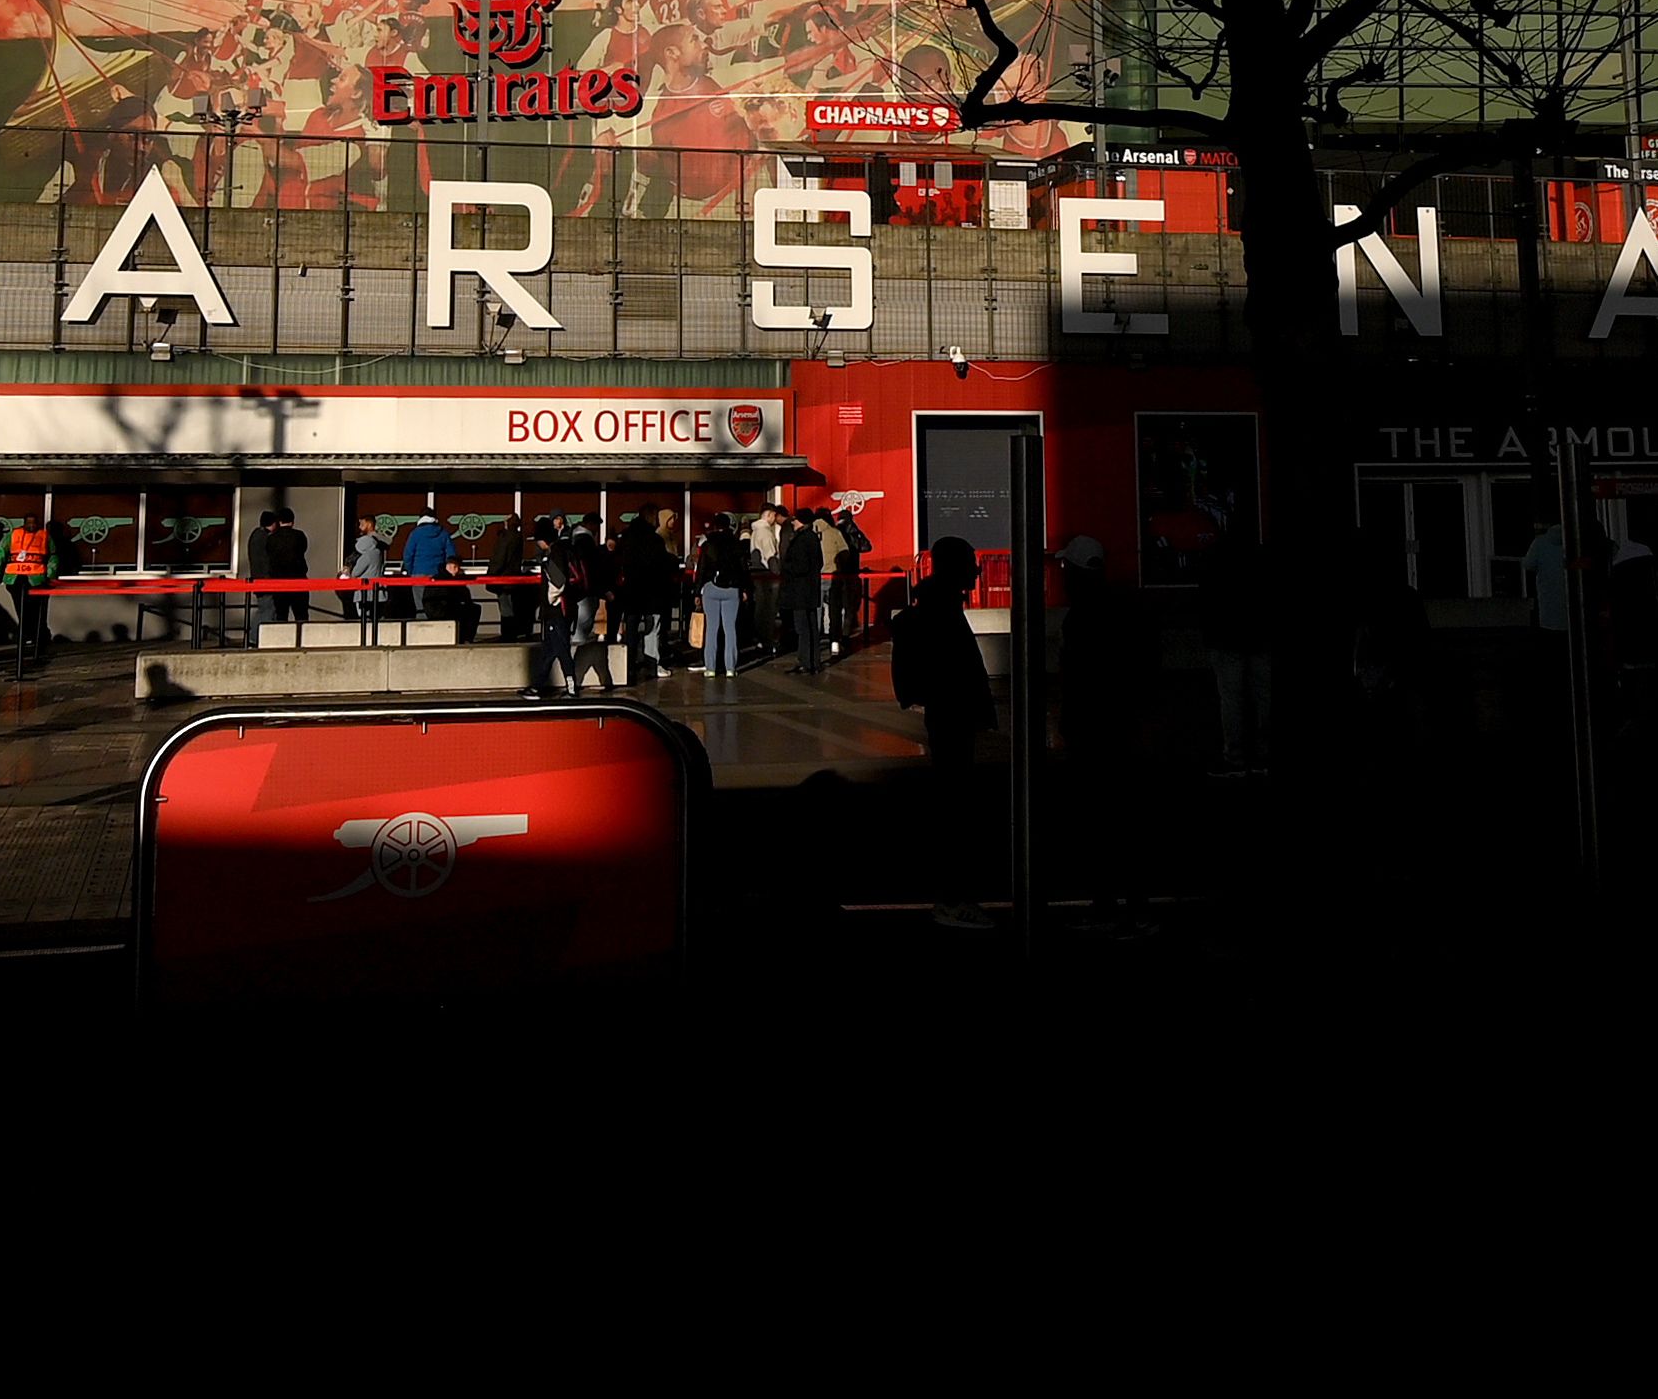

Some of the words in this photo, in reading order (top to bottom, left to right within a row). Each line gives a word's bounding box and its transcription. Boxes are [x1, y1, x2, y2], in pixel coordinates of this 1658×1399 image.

[659, 0, 682, 23] 23
[369, 64, 643, 122] Emrates
[813, 105, 930, 126] CHAPMAN'S
[1122, 148, 1180, 165] Arsenal
[1603, 163, 1630, 179] The
[507, 410, 584, 443] BOX
[594, 409, 713, 443] OFFICE
[1377, 426, 1475, 459] THE
